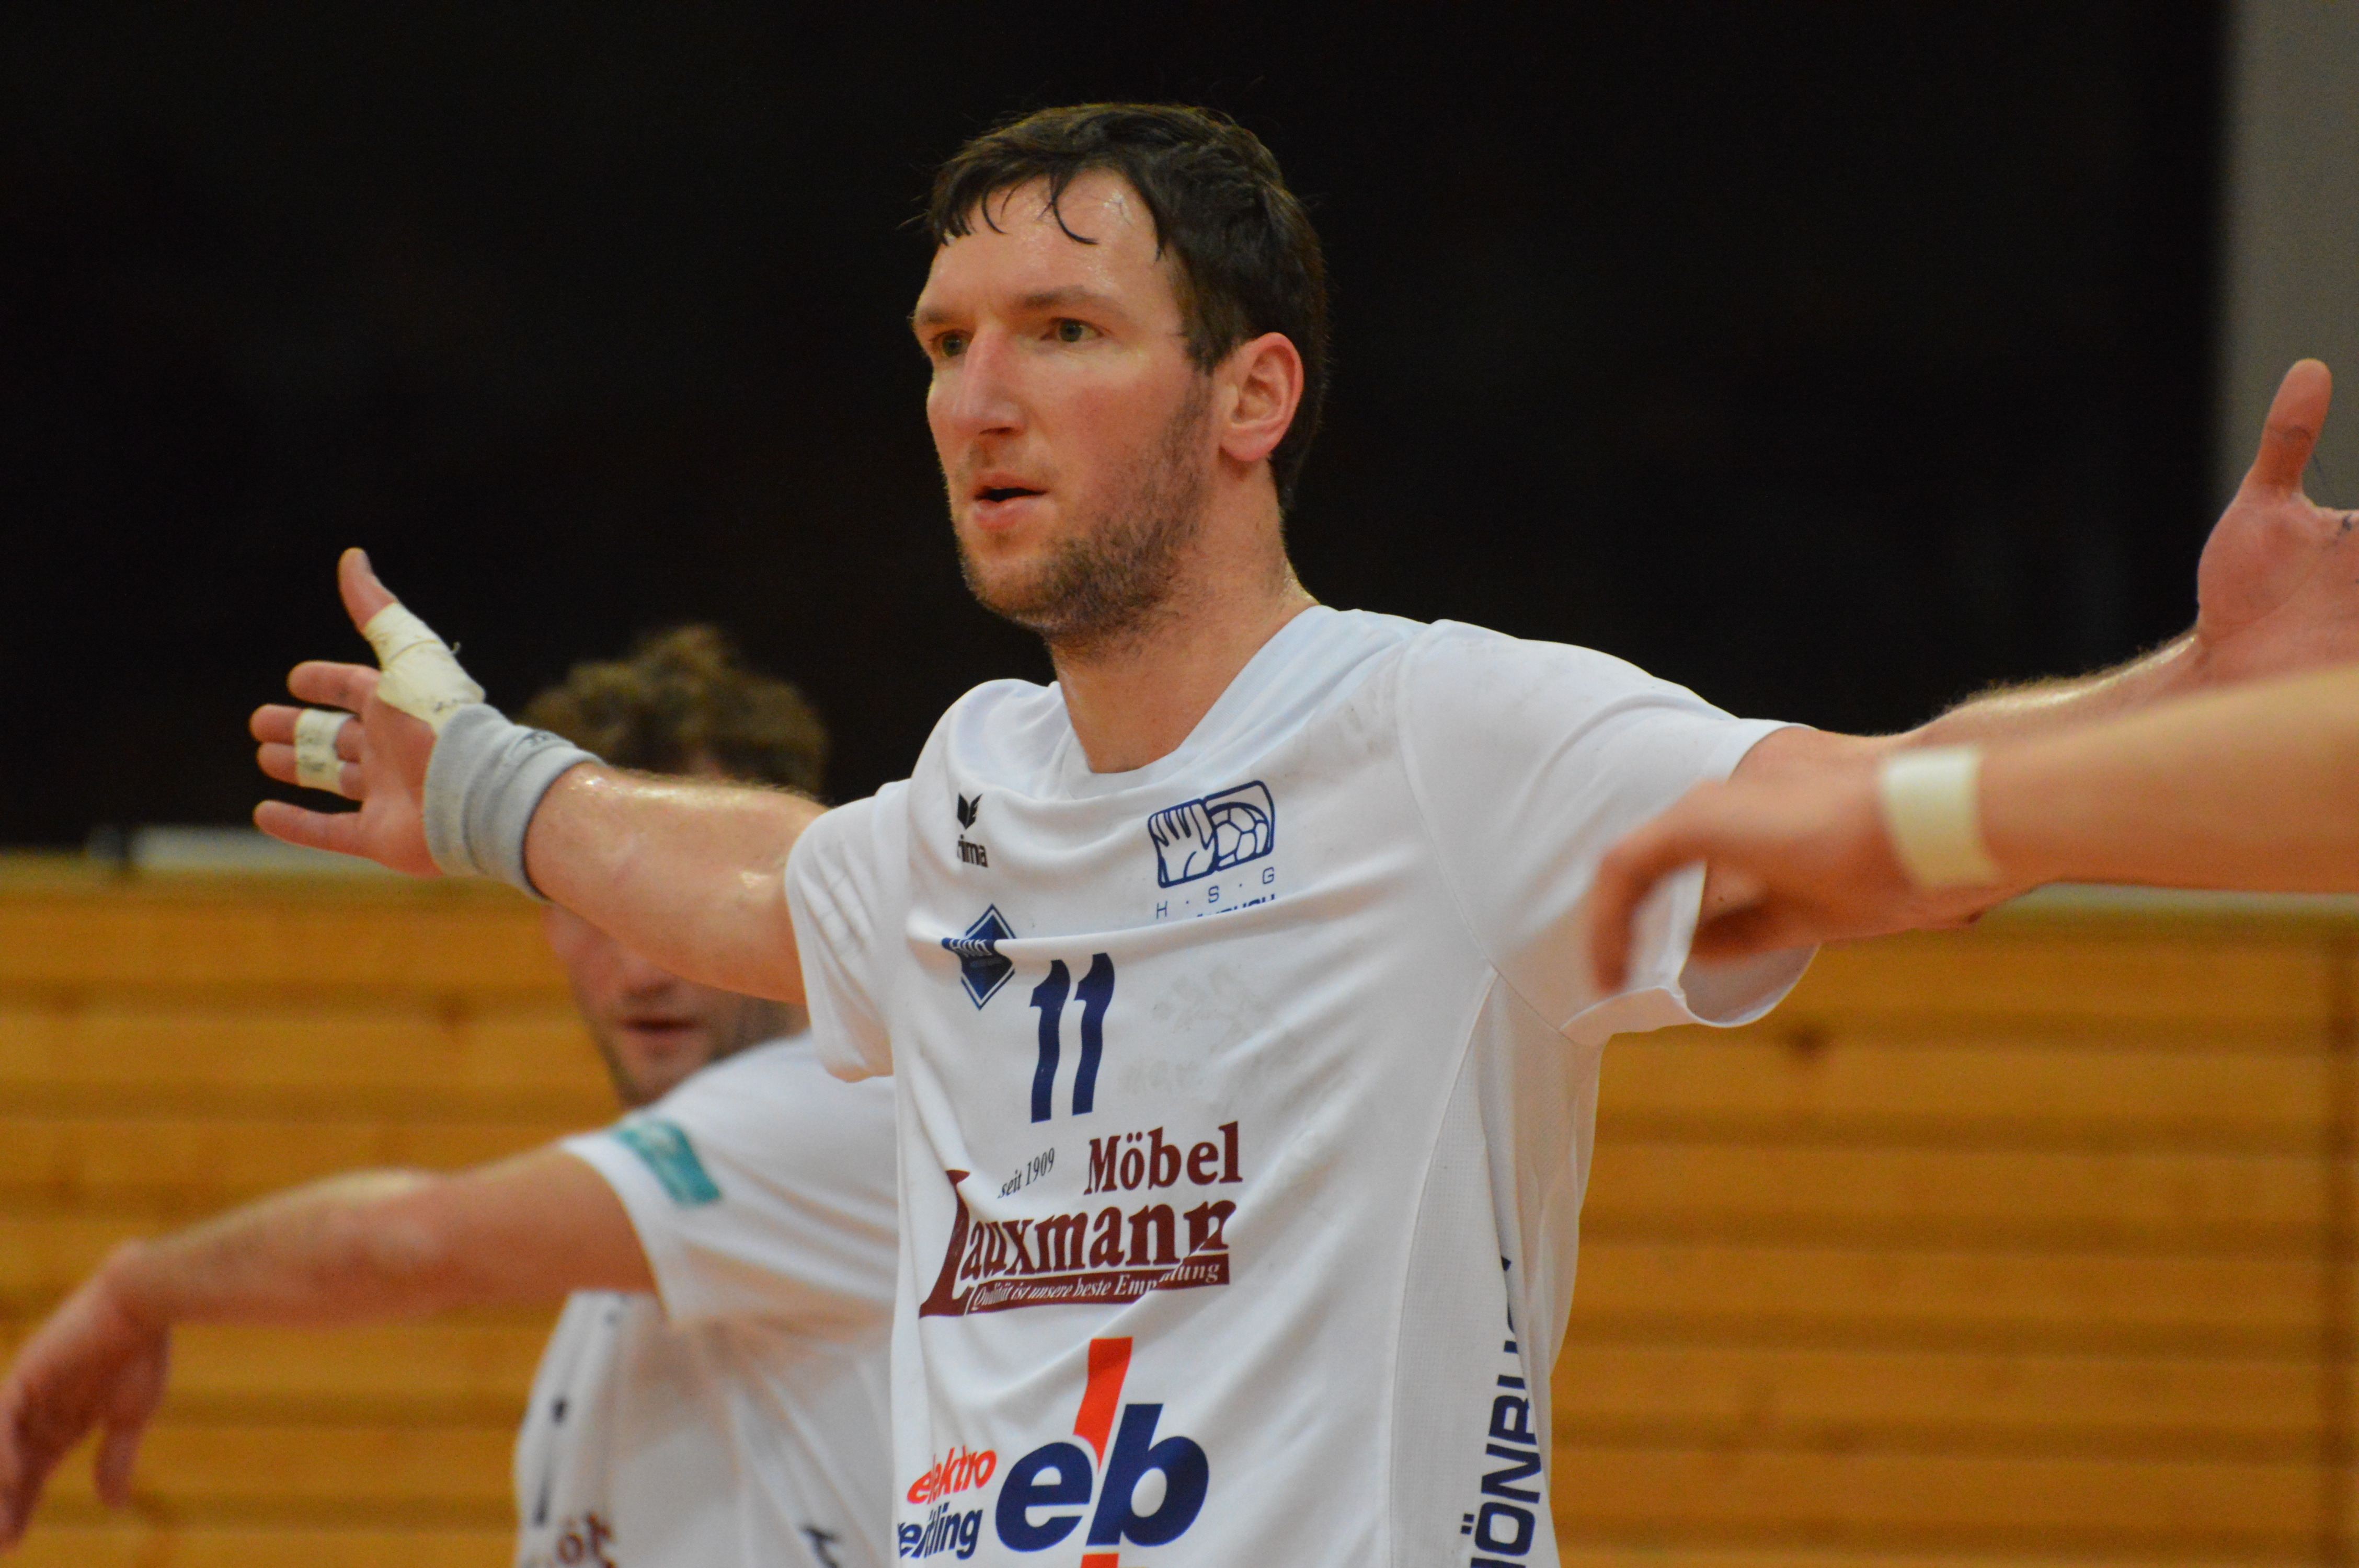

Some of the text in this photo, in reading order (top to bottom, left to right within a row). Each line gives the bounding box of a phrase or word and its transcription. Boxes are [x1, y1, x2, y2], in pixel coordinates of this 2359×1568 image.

[1030, 952, 1115, 1124] 11
[997, 1147, 1055, 1196] seit 1909
[1084, 1121, 1243, 1196] Möbel
[919, 1169, 1238, 1319] Lauxmann
[1010, 1282, 1032, 1301] ist
[1027, 1284, 1073, 1300] unsere
[1072, 1277, 1112, 1296] beste
